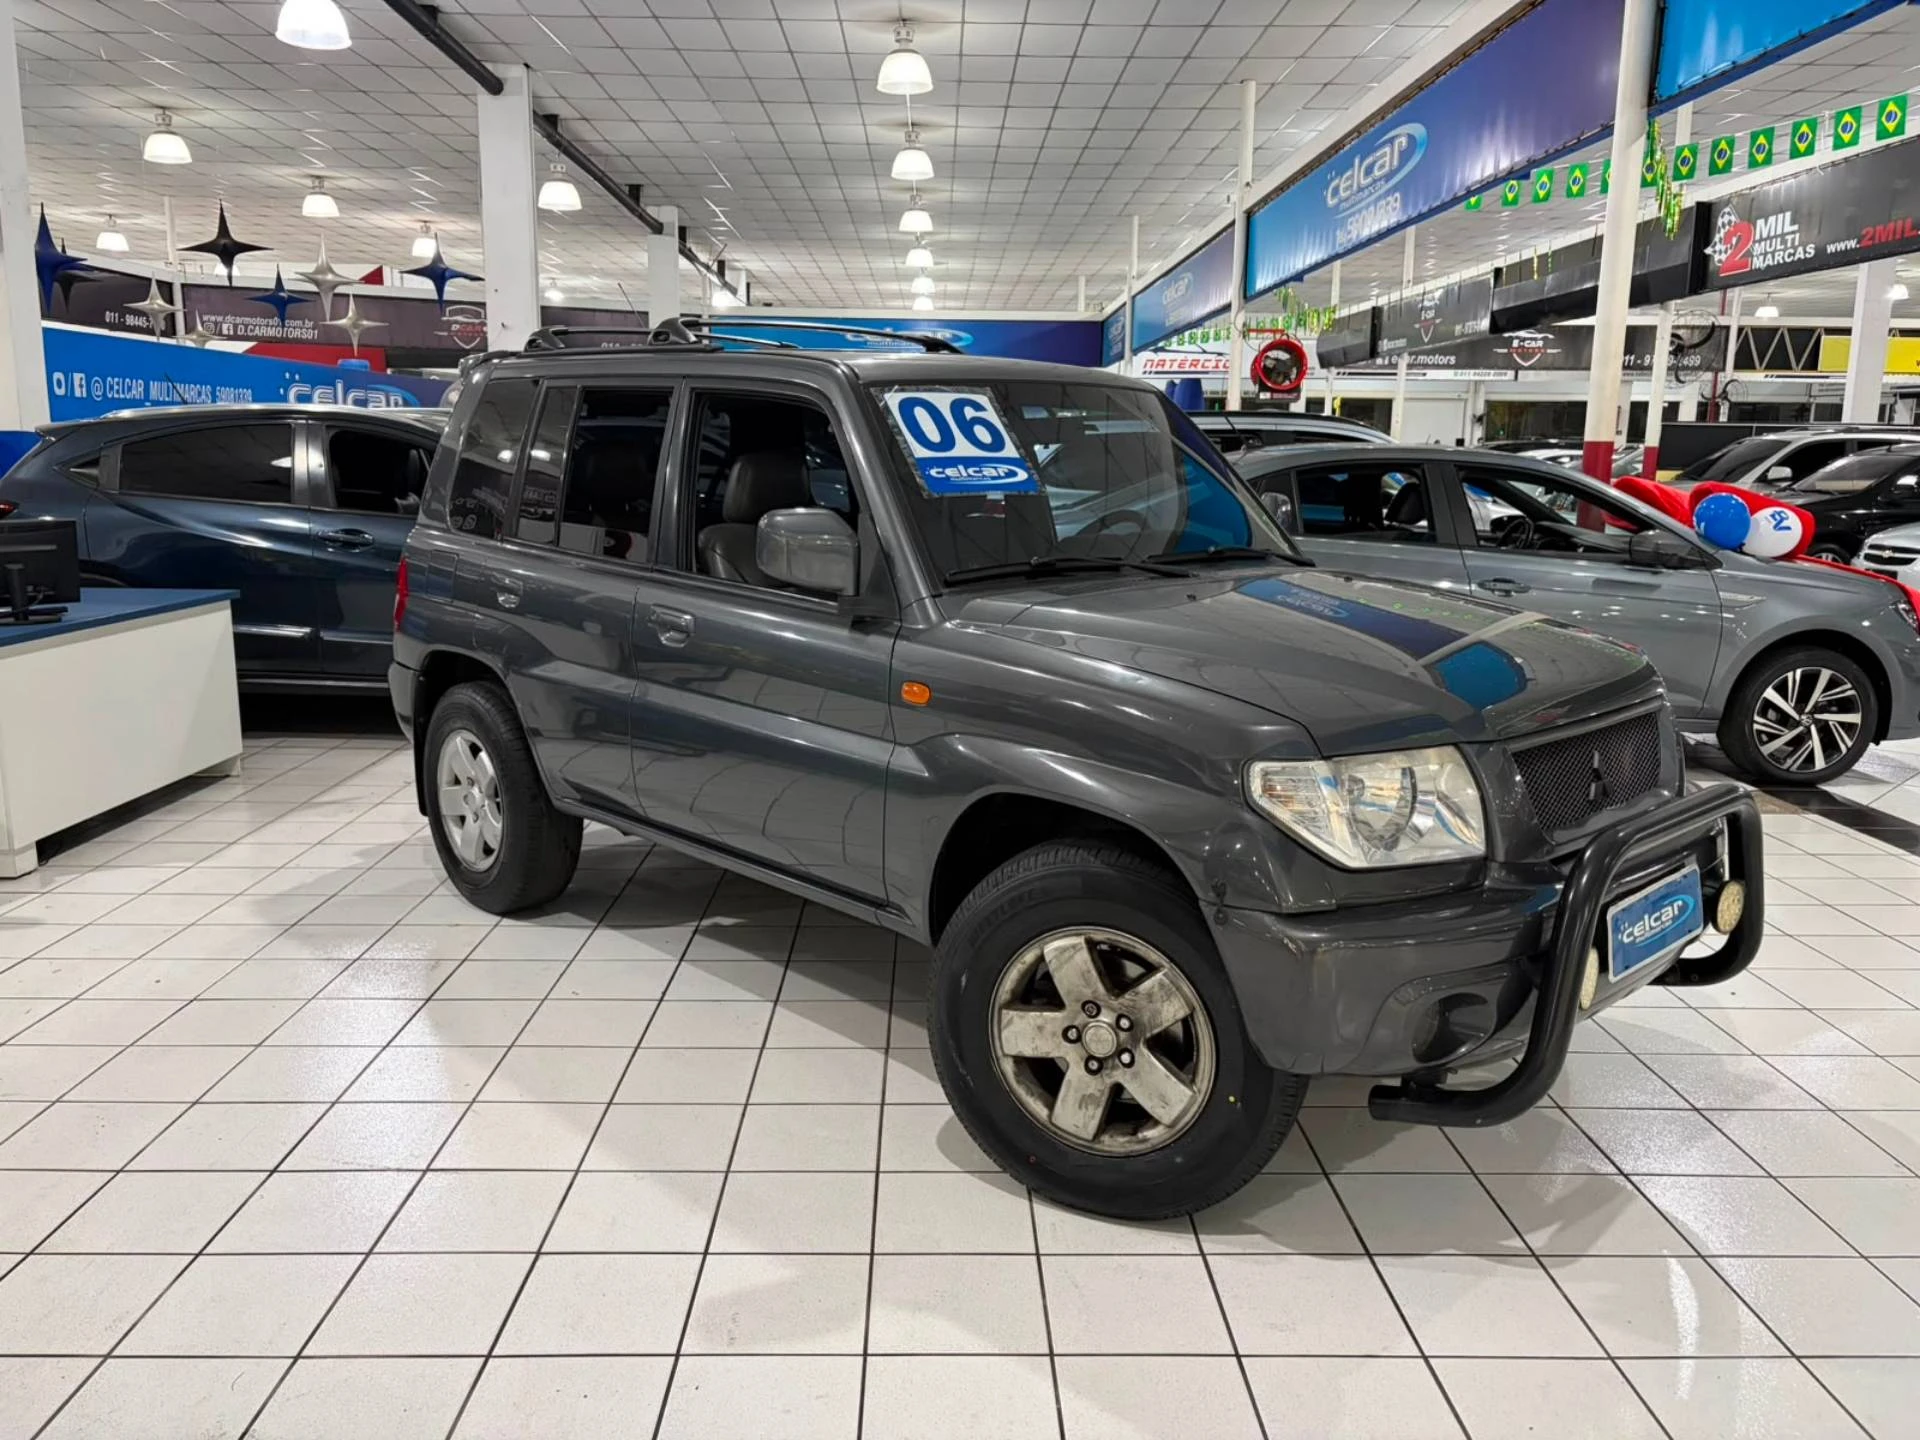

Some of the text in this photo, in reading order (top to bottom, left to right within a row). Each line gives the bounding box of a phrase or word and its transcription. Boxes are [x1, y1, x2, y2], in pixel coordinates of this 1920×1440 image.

[1327, 134, 1408, 208] celcar
[1755, 211, 1800, 241] MIL
[1751, 244, 1816, 271] MARCAS
[1753, 232, 1800, 257] MULTI
[288, 379, 404, 408] celcar
[898, 396, 1006, 453] 06
[929, 464, 1009, 478] celcar
[1623, 900, 1684, 943] celcar
